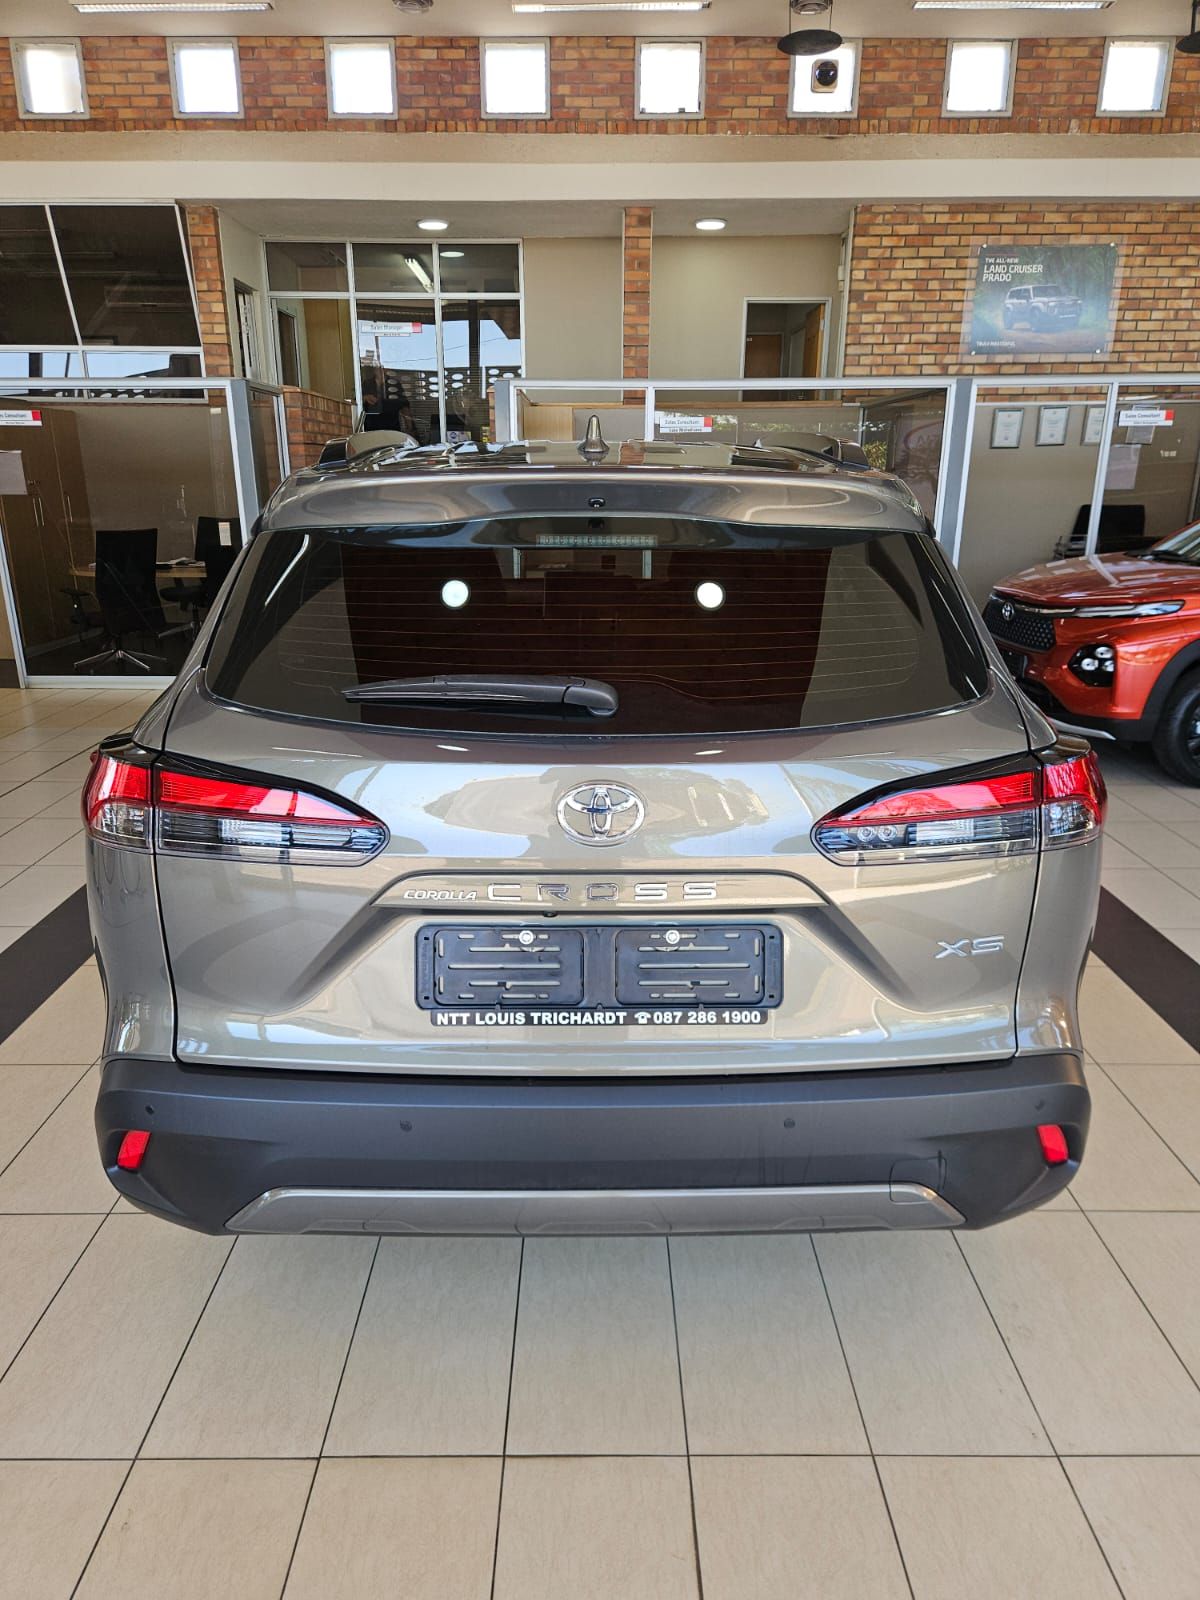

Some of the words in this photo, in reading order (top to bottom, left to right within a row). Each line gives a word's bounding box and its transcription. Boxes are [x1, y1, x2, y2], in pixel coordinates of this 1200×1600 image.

[984, 264, 1007, 273] LAND
[1008, 264, 1044, 273] CRUISER
[983, 273, 1012, 282] PRADO
[403, 889, 477, 901] COROLLA
[487, 882, 717, 902] CROSS
[436, 1011, 470, 1026] NTT
[475, 1011, 526, 1026] LOUIS
[530, 1011, 627, 1025] TRICHARDT
[652, 1010, 682, 1025] 087
[687, 1010, 717, 1024] 286
[722, 1010, 761, 1024] 1900
